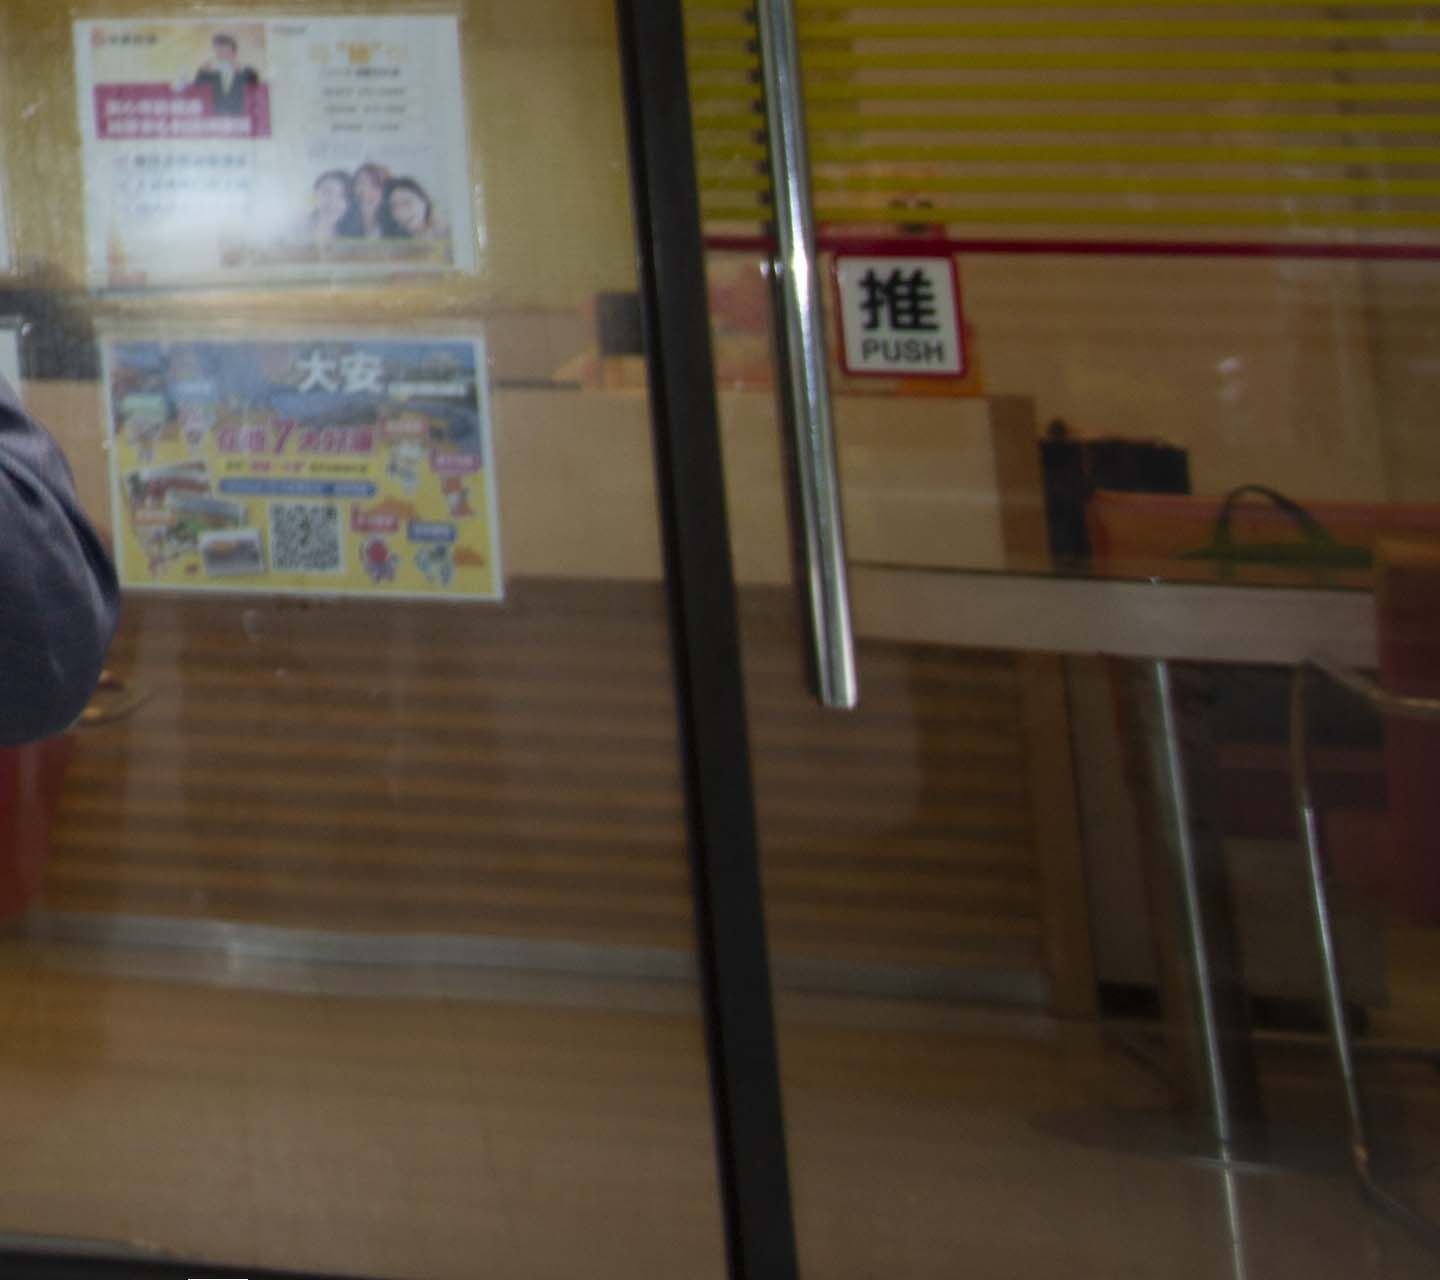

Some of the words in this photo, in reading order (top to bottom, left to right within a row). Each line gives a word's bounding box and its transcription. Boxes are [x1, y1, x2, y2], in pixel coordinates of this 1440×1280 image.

[858, 267, 940, 332] 推
[295, 349, 385, 393] 大安
[862, 337, 945, 364] PUSH
